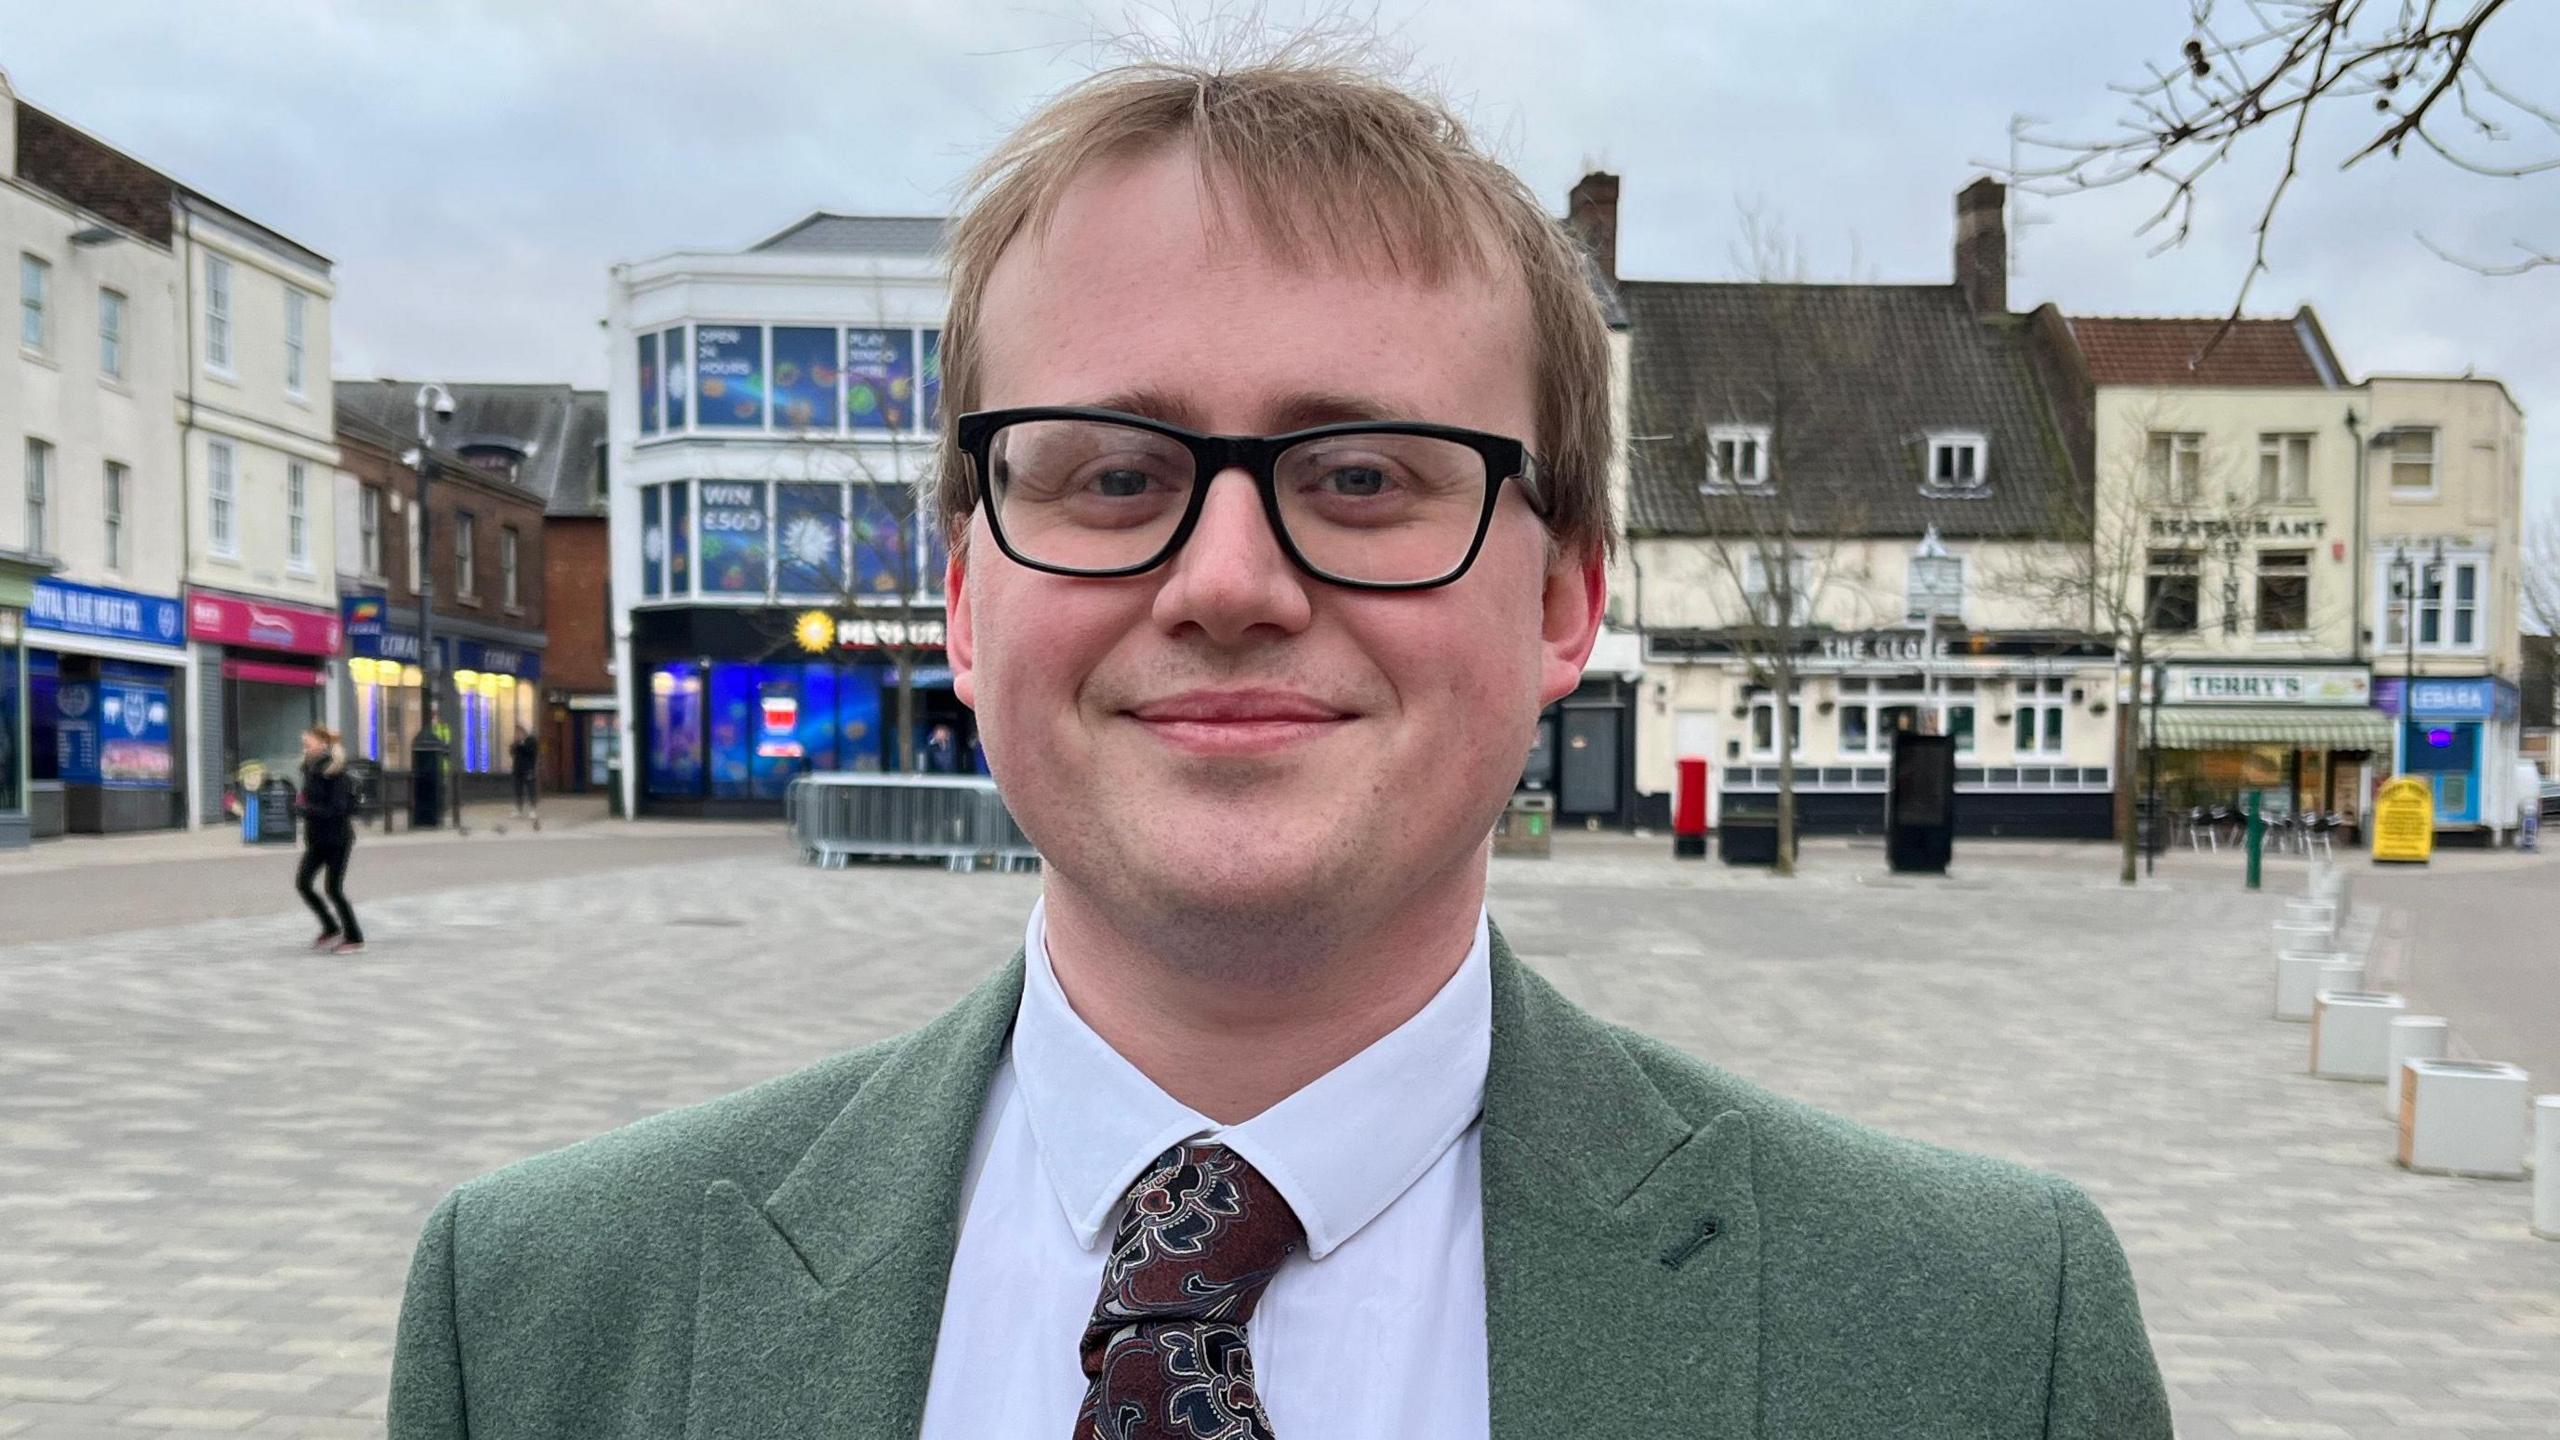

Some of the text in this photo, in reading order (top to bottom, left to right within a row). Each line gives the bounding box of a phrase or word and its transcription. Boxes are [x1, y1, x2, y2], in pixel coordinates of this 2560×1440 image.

[699, 329, 740, 344] OPEN
[850, 333, 887, 347] PLAY
[699, 361, 750, 375] HOURS
[704, 485, 752, 506] WIN
[704, 511, 762, 531] £500
[2150, 519, 2326, 538] RESTAURANT
[65, 589, 93, 625] BLUE
[94, 595, 122, 629] MEAT
[1823, 637, 1864, 660] THE
[2191, 676, 2300, 697] TERRY'S
[2411, 683, 2483, 709] LEBARA
